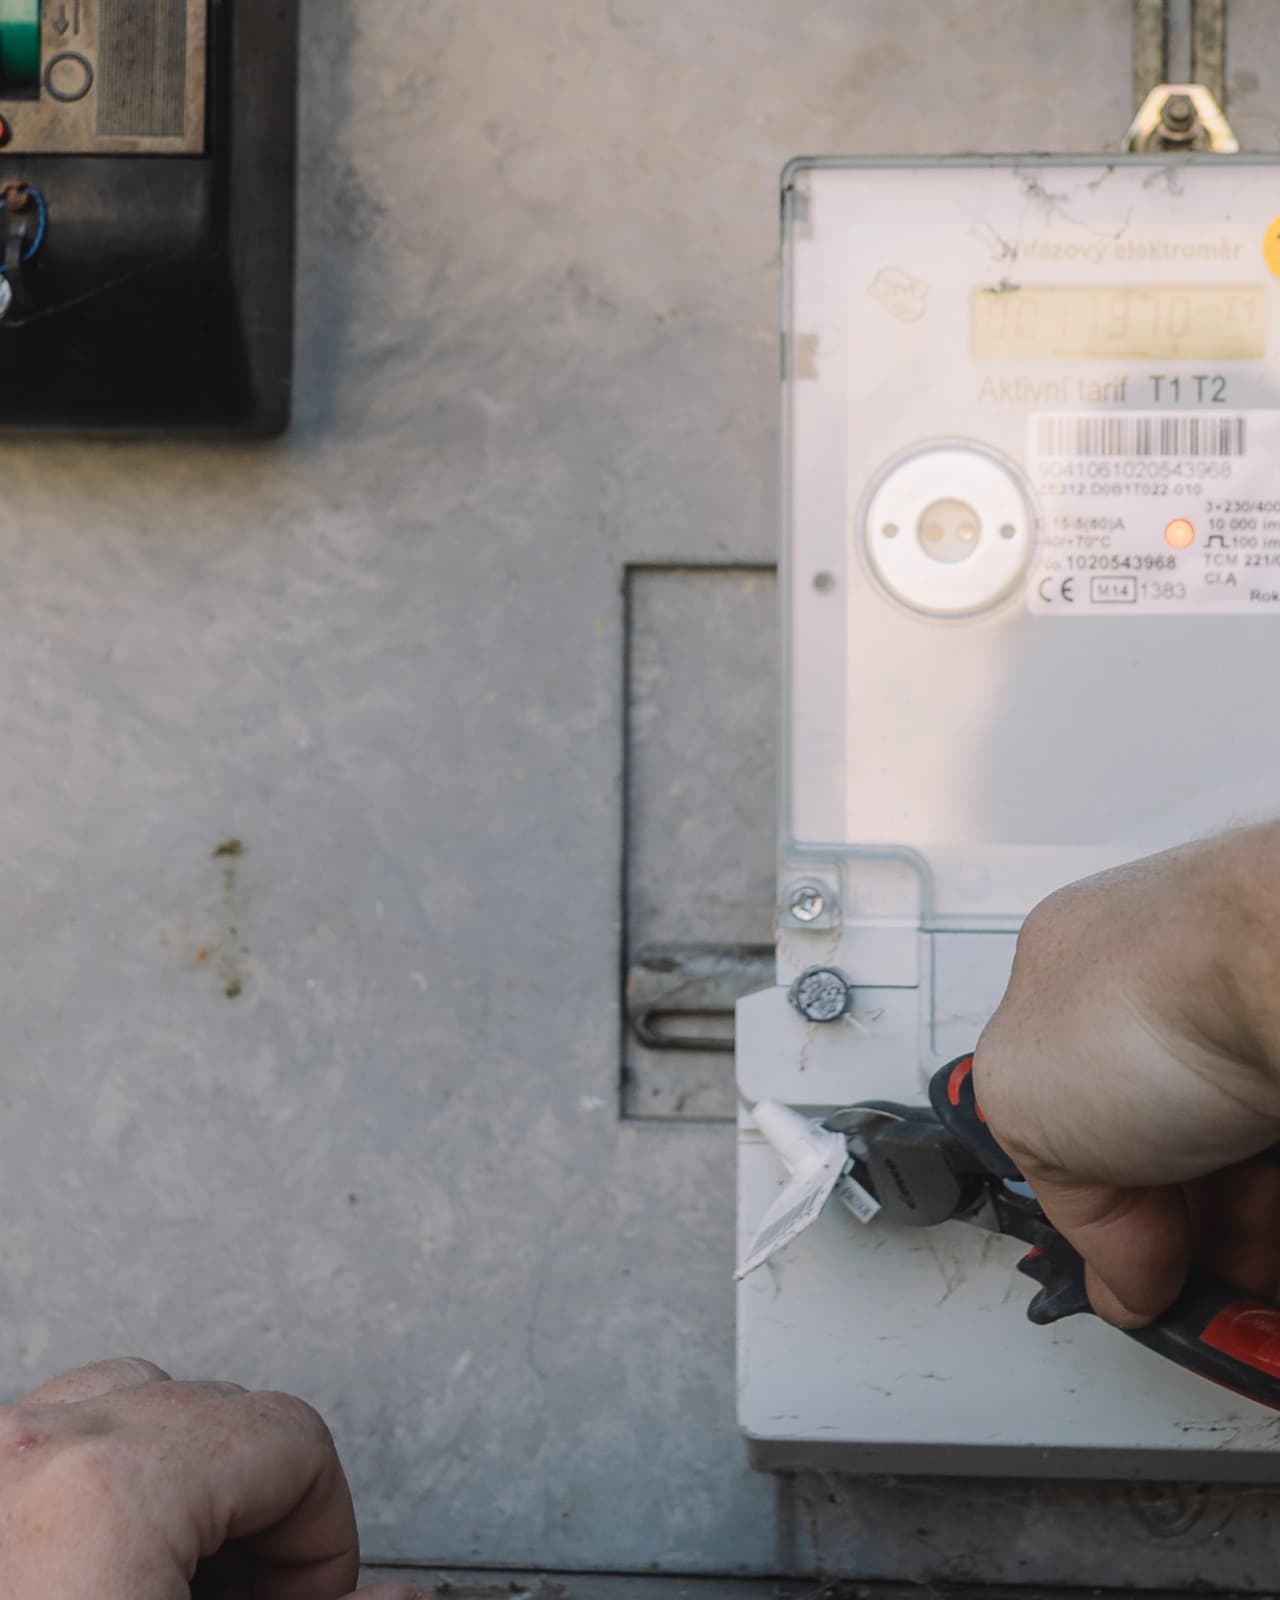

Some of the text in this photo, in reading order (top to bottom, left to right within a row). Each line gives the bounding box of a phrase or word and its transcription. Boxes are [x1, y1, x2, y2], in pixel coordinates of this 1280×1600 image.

[976, 374, 1227, 403] Aktivní tarif T1 T2
[1209, 518, 1225, 530] 10
[1141, 582, 1187, 600] 1383
